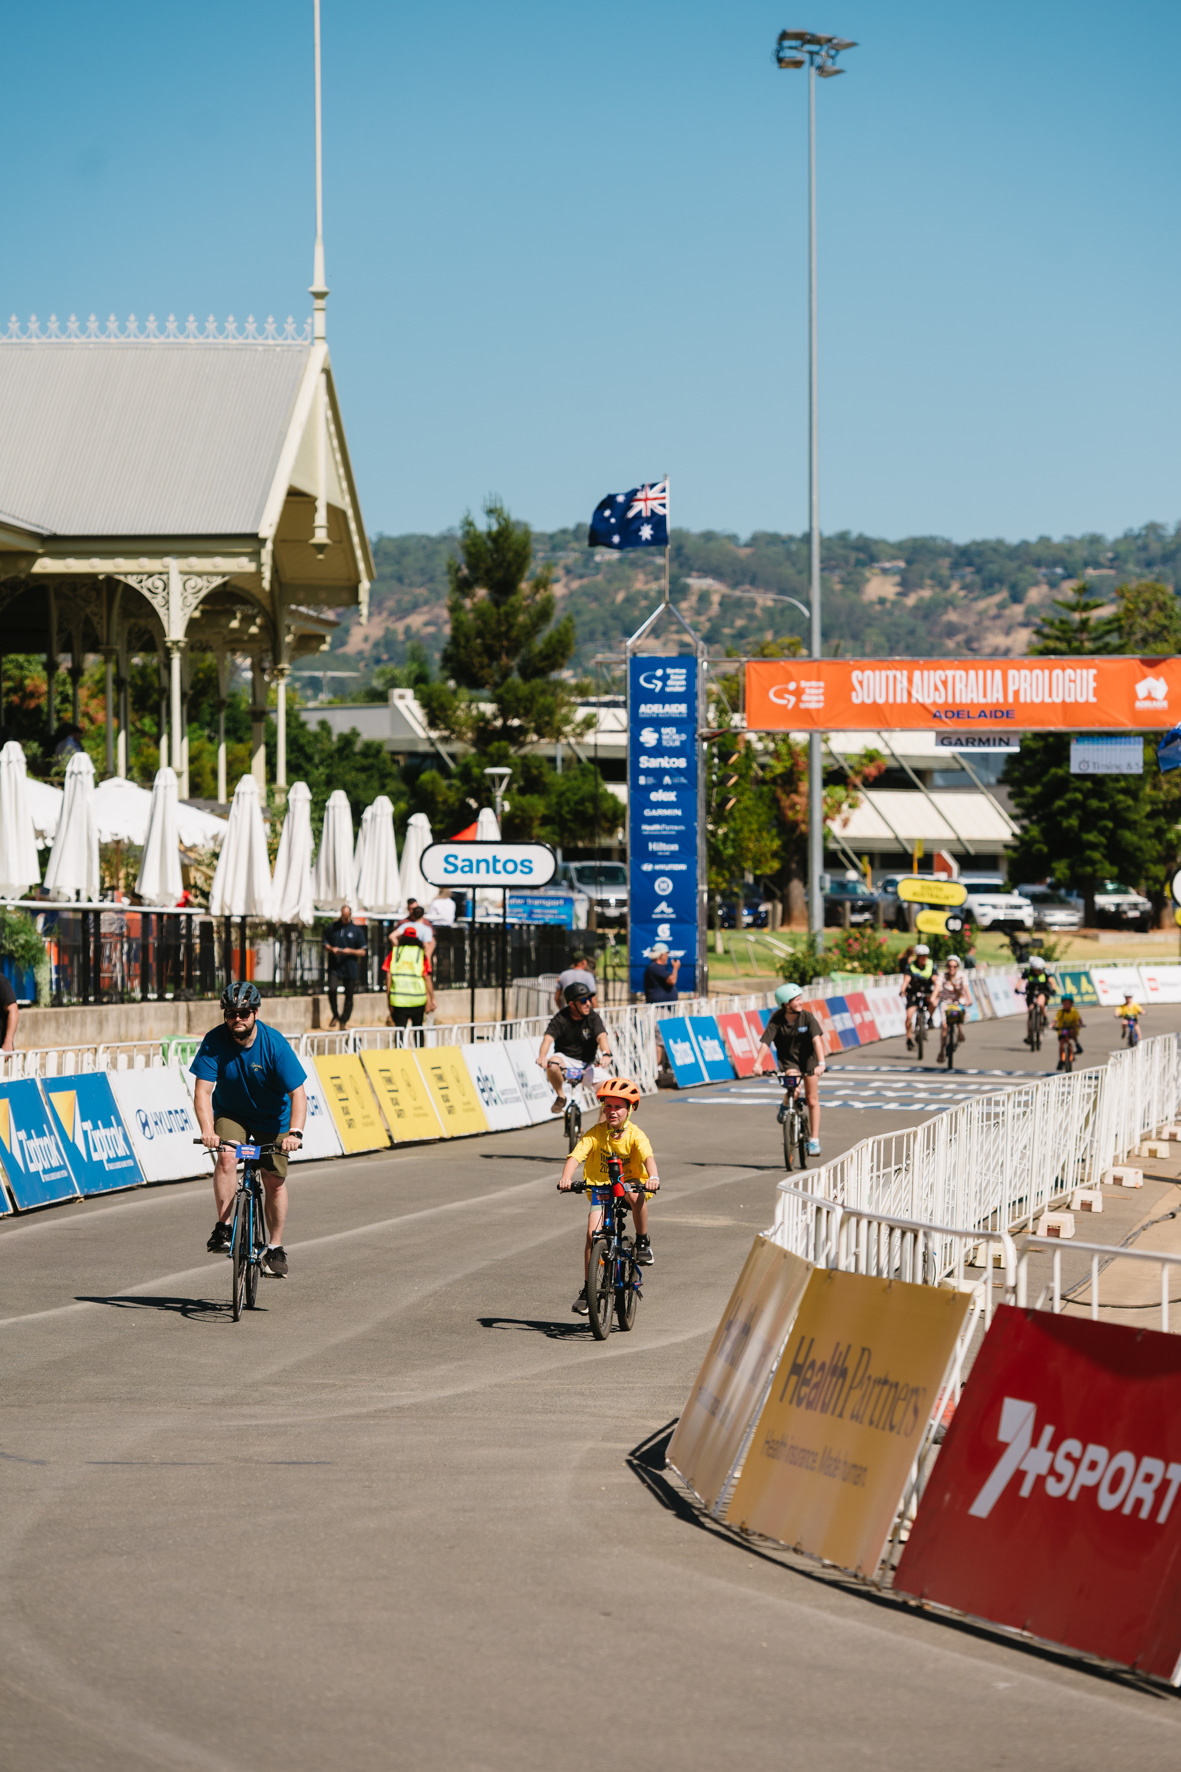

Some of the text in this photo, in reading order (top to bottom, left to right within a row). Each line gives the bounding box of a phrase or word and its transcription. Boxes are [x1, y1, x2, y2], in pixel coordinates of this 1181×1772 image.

[851, 668, 1098, 704] SOUTH AUSTRALIA PROLOGUE
[639, 703, 688, 714] ADELAIDE
[932, 709, 1016, 719] ADELAIDE
[940, 736, 1011, 747] GARMIN
[639, 756, 688, 768] Santos
[643, 808, 682, 816] GARMIN
[648, 841, 679, 851] Hilton
[443, 854, 534, 875] Santos
[151, 1108, 194, 1136] HYUNDAI
[16, 1124, 64, 1182] Ziptrak
[81, 1115, 131, 1171] Ziptrak
[779, 1336, 852, 1418] Health
[849, 1347, 927, 1438] Partners
[761, 1429, 789, 1460] Health
[817, 1445, 842, 1478] Made
